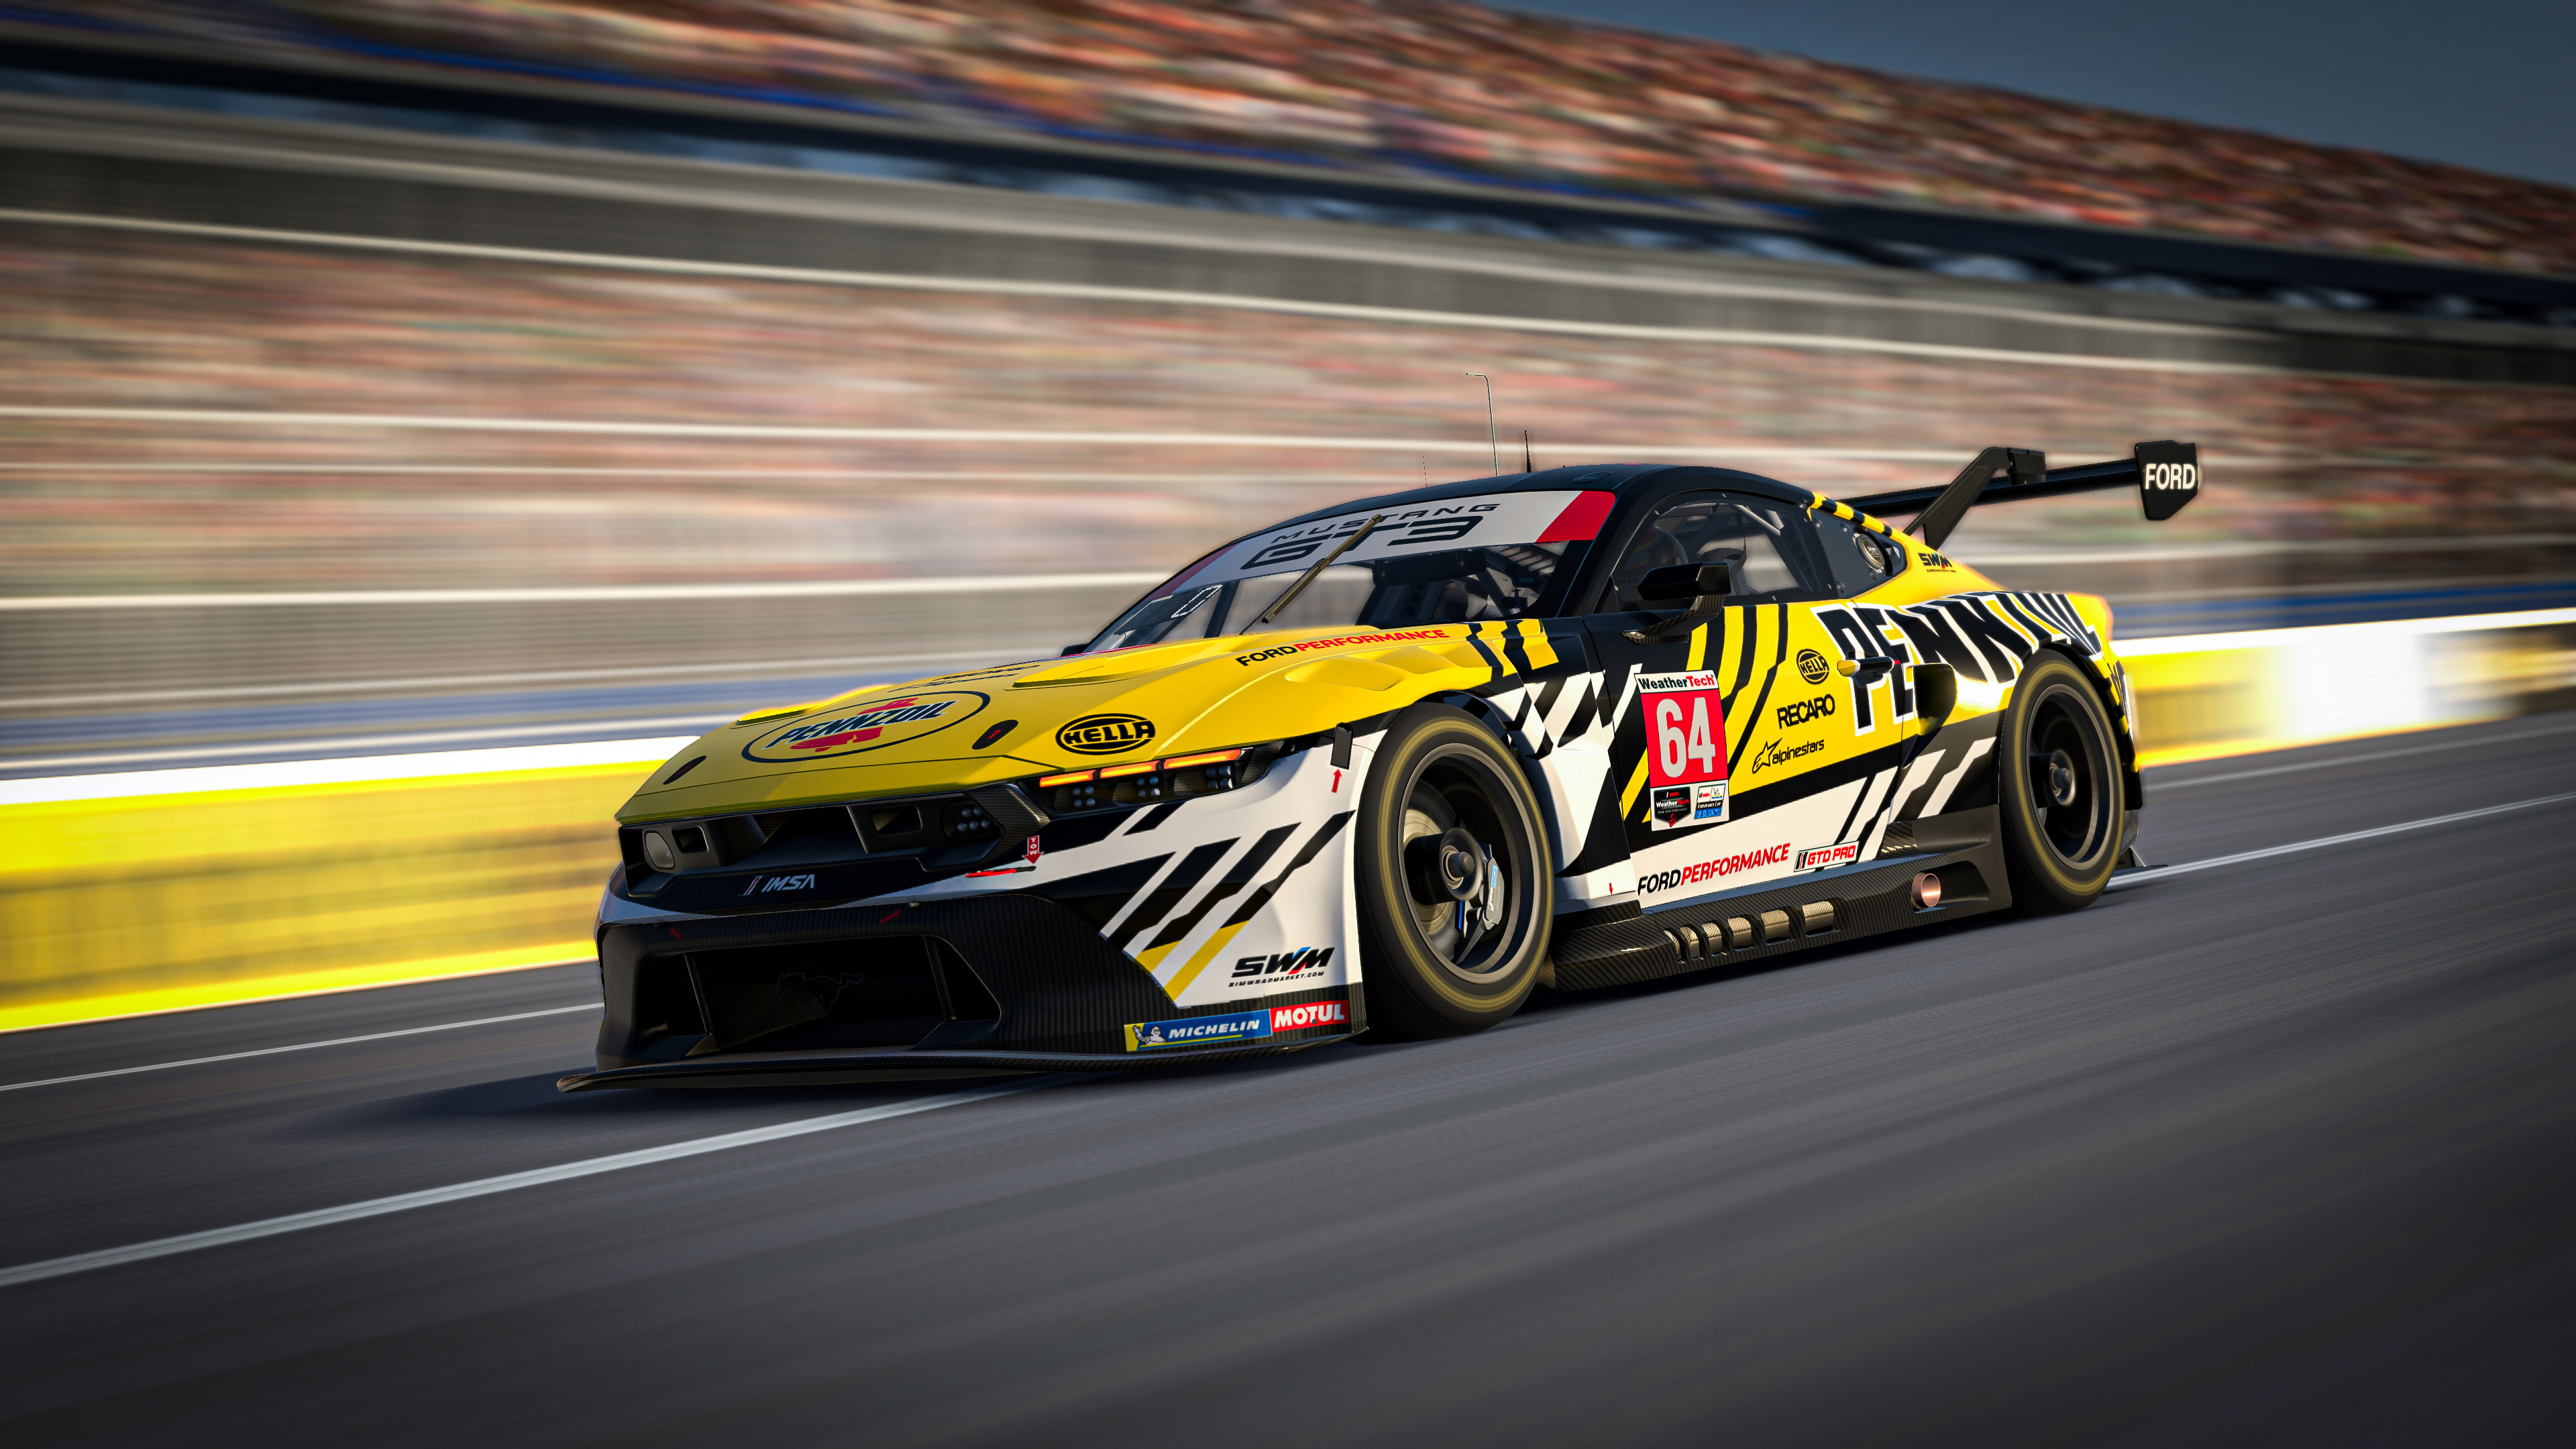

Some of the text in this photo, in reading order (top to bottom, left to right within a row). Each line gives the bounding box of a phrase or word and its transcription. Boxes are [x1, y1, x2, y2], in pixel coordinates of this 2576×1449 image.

[2145, 463, 2196, 490] FORD
[1271, 503, 1501, 543] MUSTANG
[1240, 515, 1484, 570] GT3
[1917, 552, 1953, 569] SWM
[1799, 655, 1830, 675] HELLA
[1638, 674, 1715, 690] WeatherTech
[761, 700, 961, 750] PENNZOIL
[1776, 694, 1836, 730] RECARO
[1063, 719, 1156, 745] HELLA
[1656, 696, 1716, 778] 64
[1772, 739, 1825, 765] alpinestars
[1030, 837, 1038, 855] TOW
[1807, 845, 1856, 866] GTD PRO
[761, 873, 815, 893] IMSA
[1230, 947, 1335, 978] SWM
[1274, 1002, 1346, 1028] MOTUL
[1169, 1019, 1260, 1038] MICHELIN
